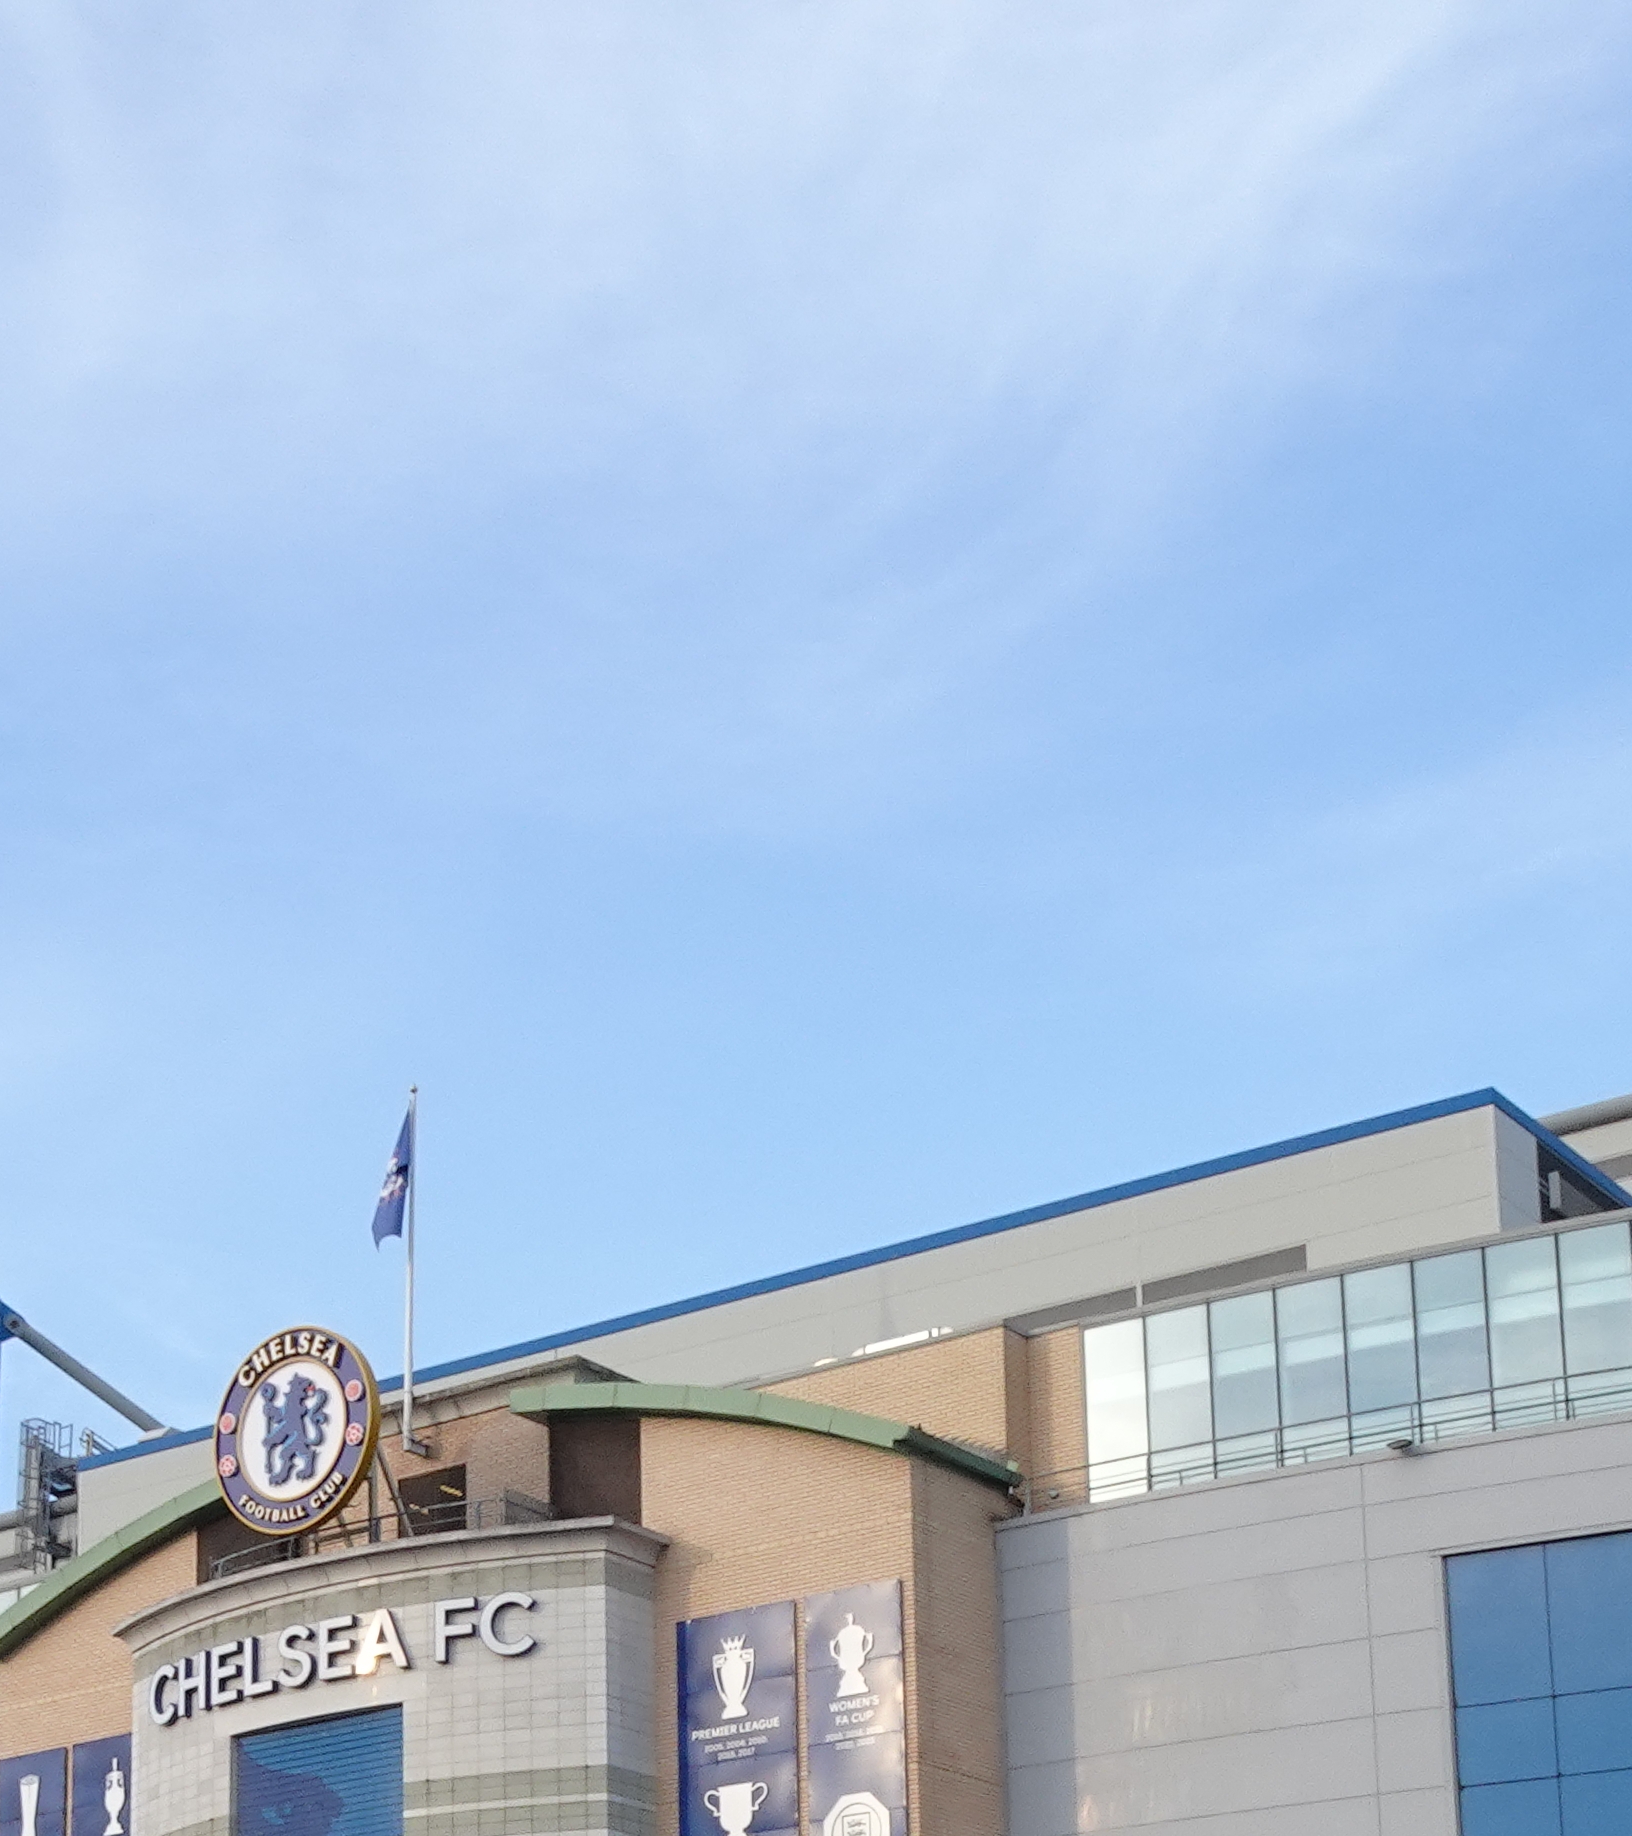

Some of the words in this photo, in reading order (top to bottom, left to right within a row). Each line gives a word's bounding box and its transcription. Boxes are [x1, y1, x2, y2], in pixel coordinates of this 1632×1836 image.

[238, 1331, 340, 1387] CHELSEA
[238, 1494, 306, 1522] FOOTBALL
[310, 1471, 343, 1508] CLUB
[149, 1608, 410, 1726] CHELSEA
[434, 1591, 536, 1663] FC
[828, 1695, 879, 1712] WOMEN'S
[835, 1715, 849, 1726] FA
[851, 1709, 874, 1723] CUP
[691, 1724, 737, 1741] PREMIER
[739, 1716, 780, 1733] LEAGUE
